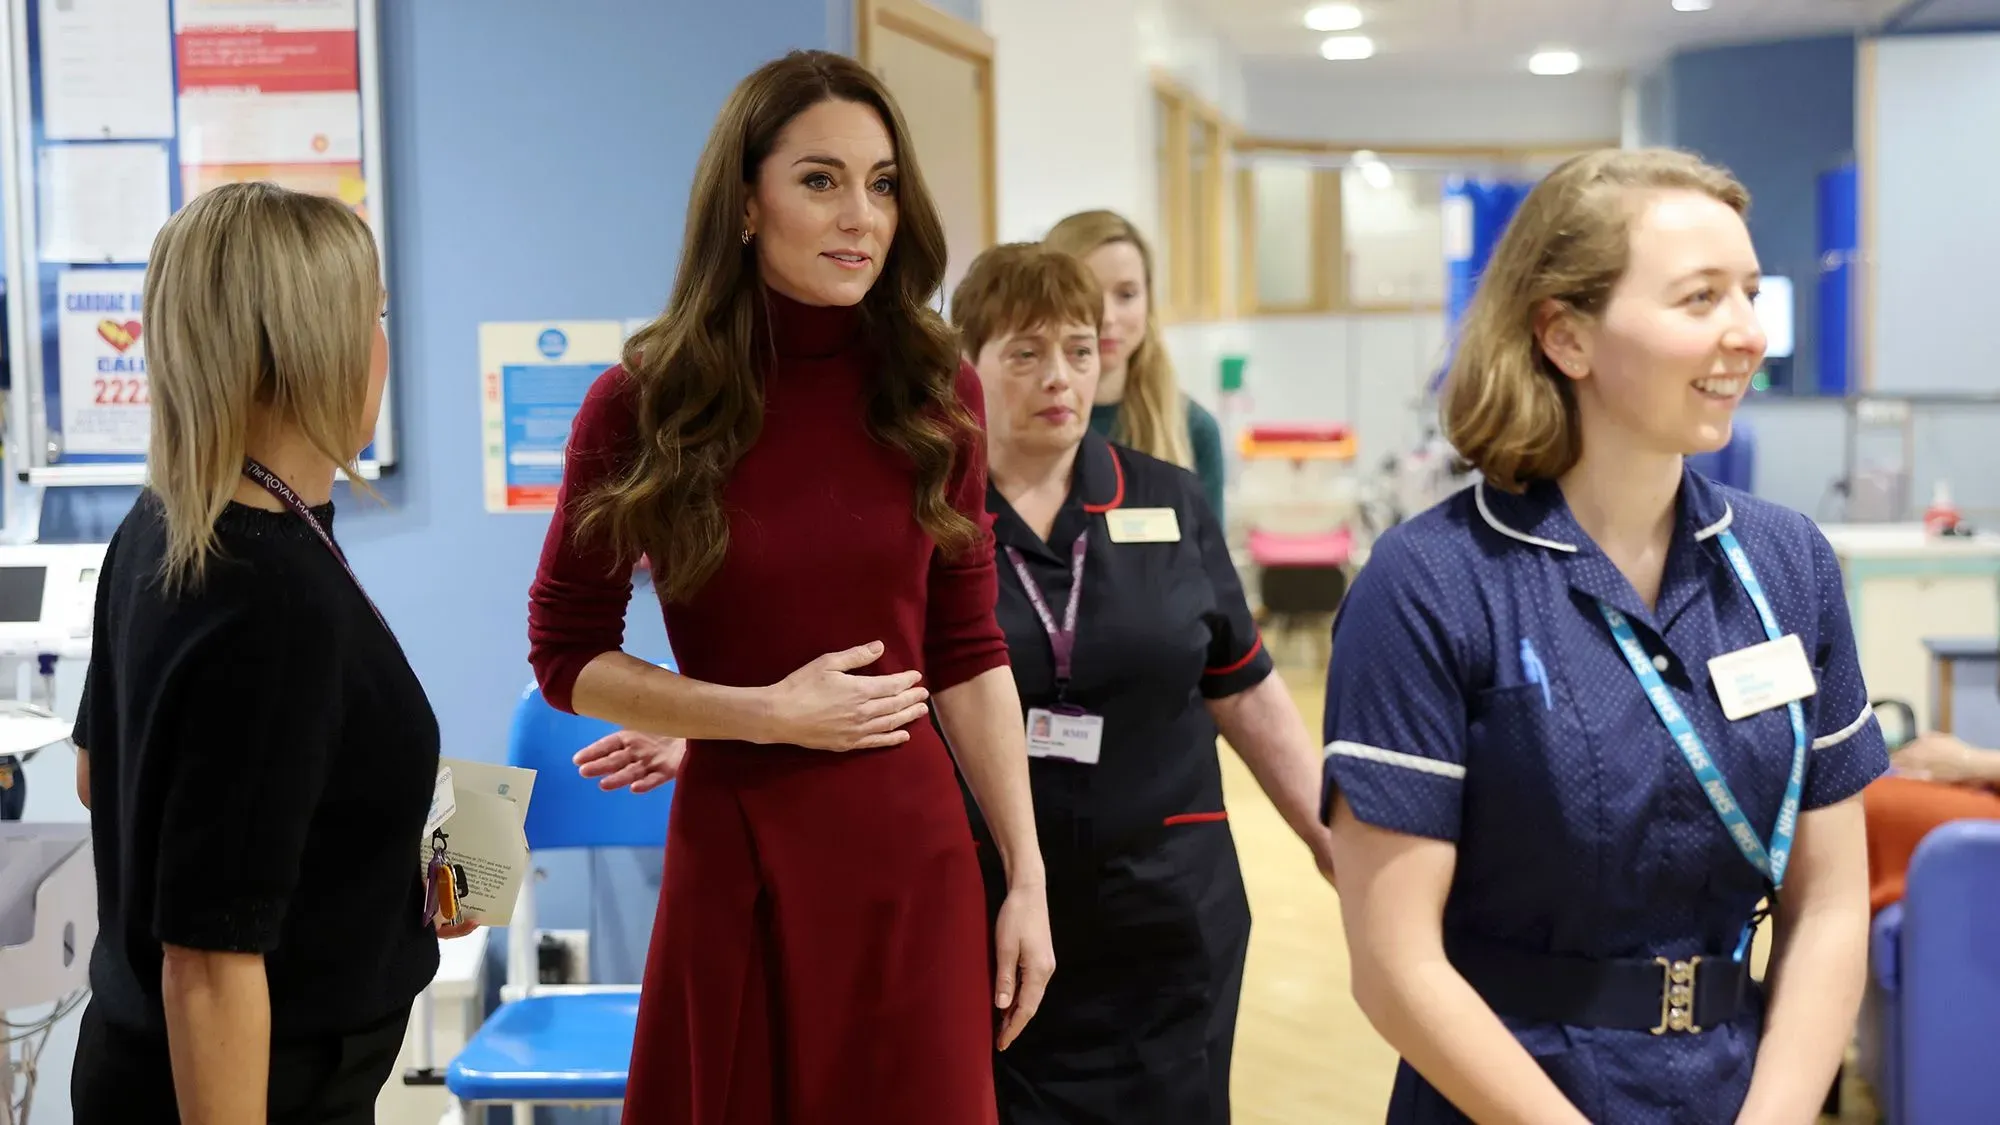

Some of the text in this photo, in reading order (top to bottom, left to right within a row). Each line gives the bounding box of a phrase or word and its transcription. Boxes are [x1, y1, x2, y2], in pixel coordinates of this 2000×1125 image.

[247, 462, 333, 547] The ROYAL MARSDEN
[1677, 731, 1710, 770] NHS
[1704, 779, 1737, 815] NHS
[1777, 796, 1798, 838] NHS
[1730, 822, 1759, 852] NHS
